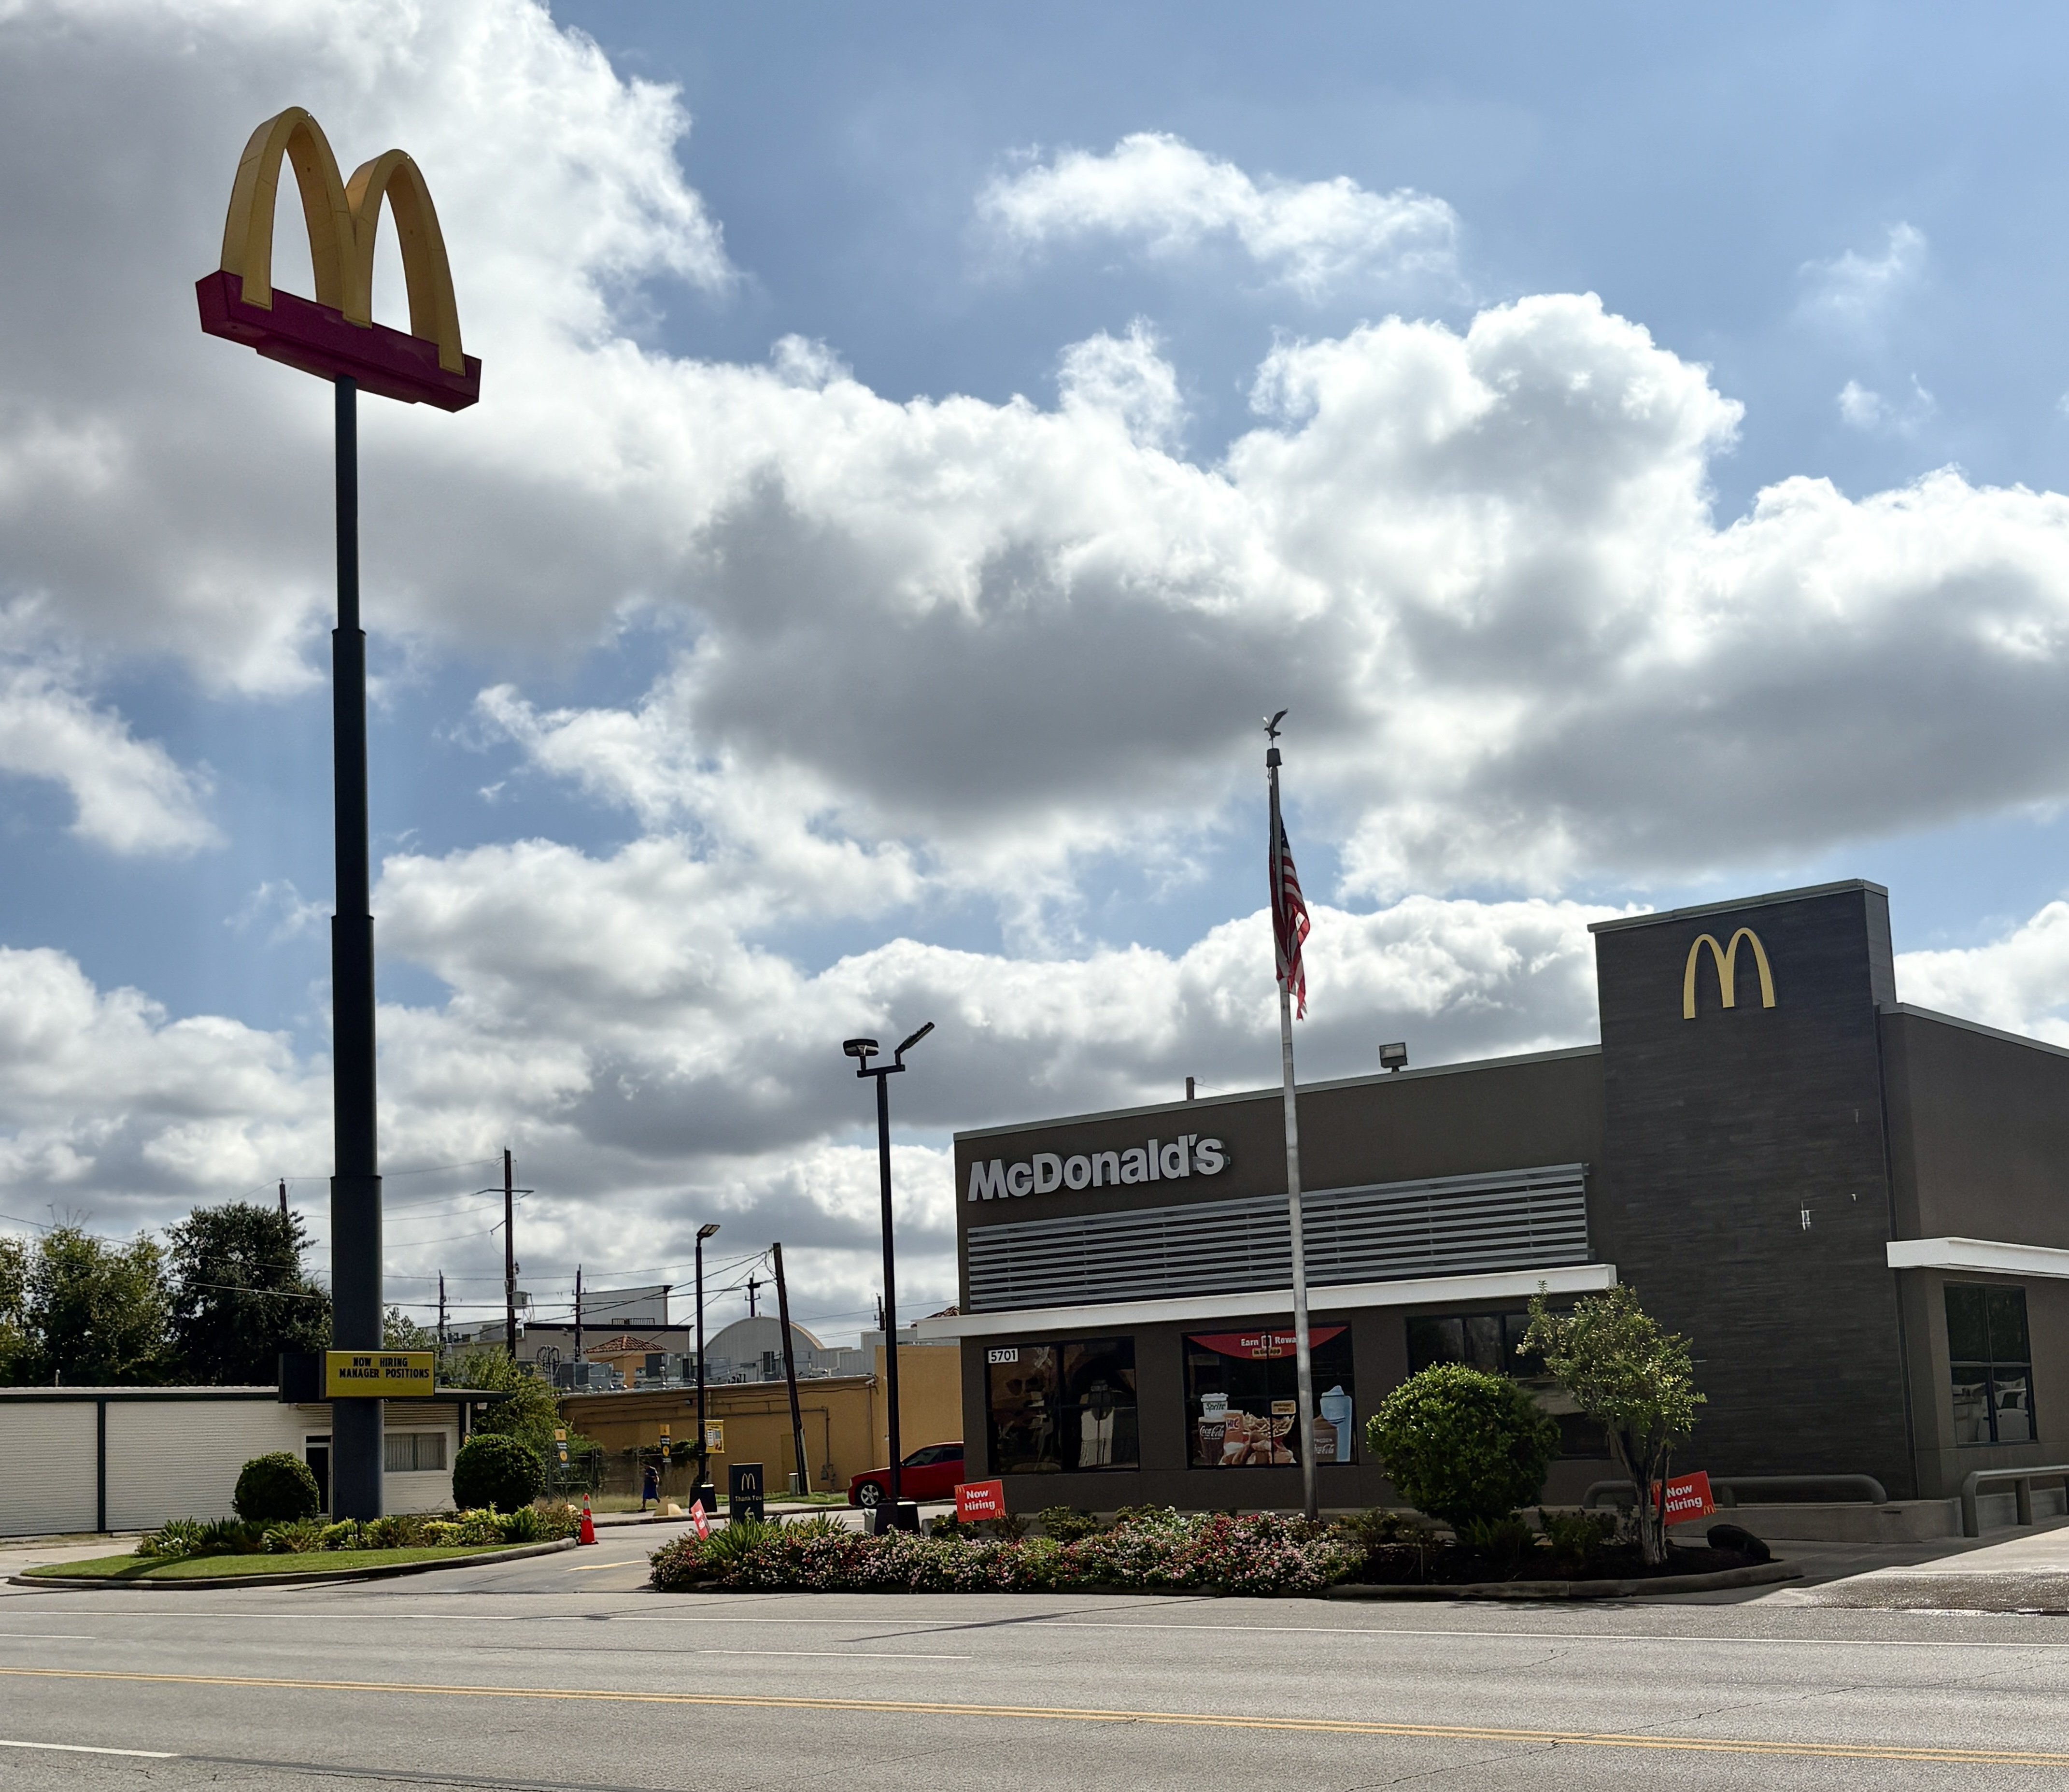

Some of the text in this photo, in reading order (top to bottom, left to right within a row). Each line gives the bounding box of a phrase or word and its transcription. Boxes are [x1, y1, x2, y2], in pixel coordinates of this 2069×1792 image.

[967, 1134, 1225, 1202] McDonald's
[1241, 1338, 1259, 1347] Earn
[991, 1350, 1015, 1362] 5701
[353, 1357, 408, 1367] NOW HIRING
[339, 1368, 429, 1378] MANAGER POSITIONS
[1206, 1403, 1226, 1412] Sprite
[966, 1490, 989, 1499] Now
[1666, 1484, 1692, 1498] Now
[964, 1500, 995, 1511] Hiring
[1666, 1496, 1703, 1513] Hiring
